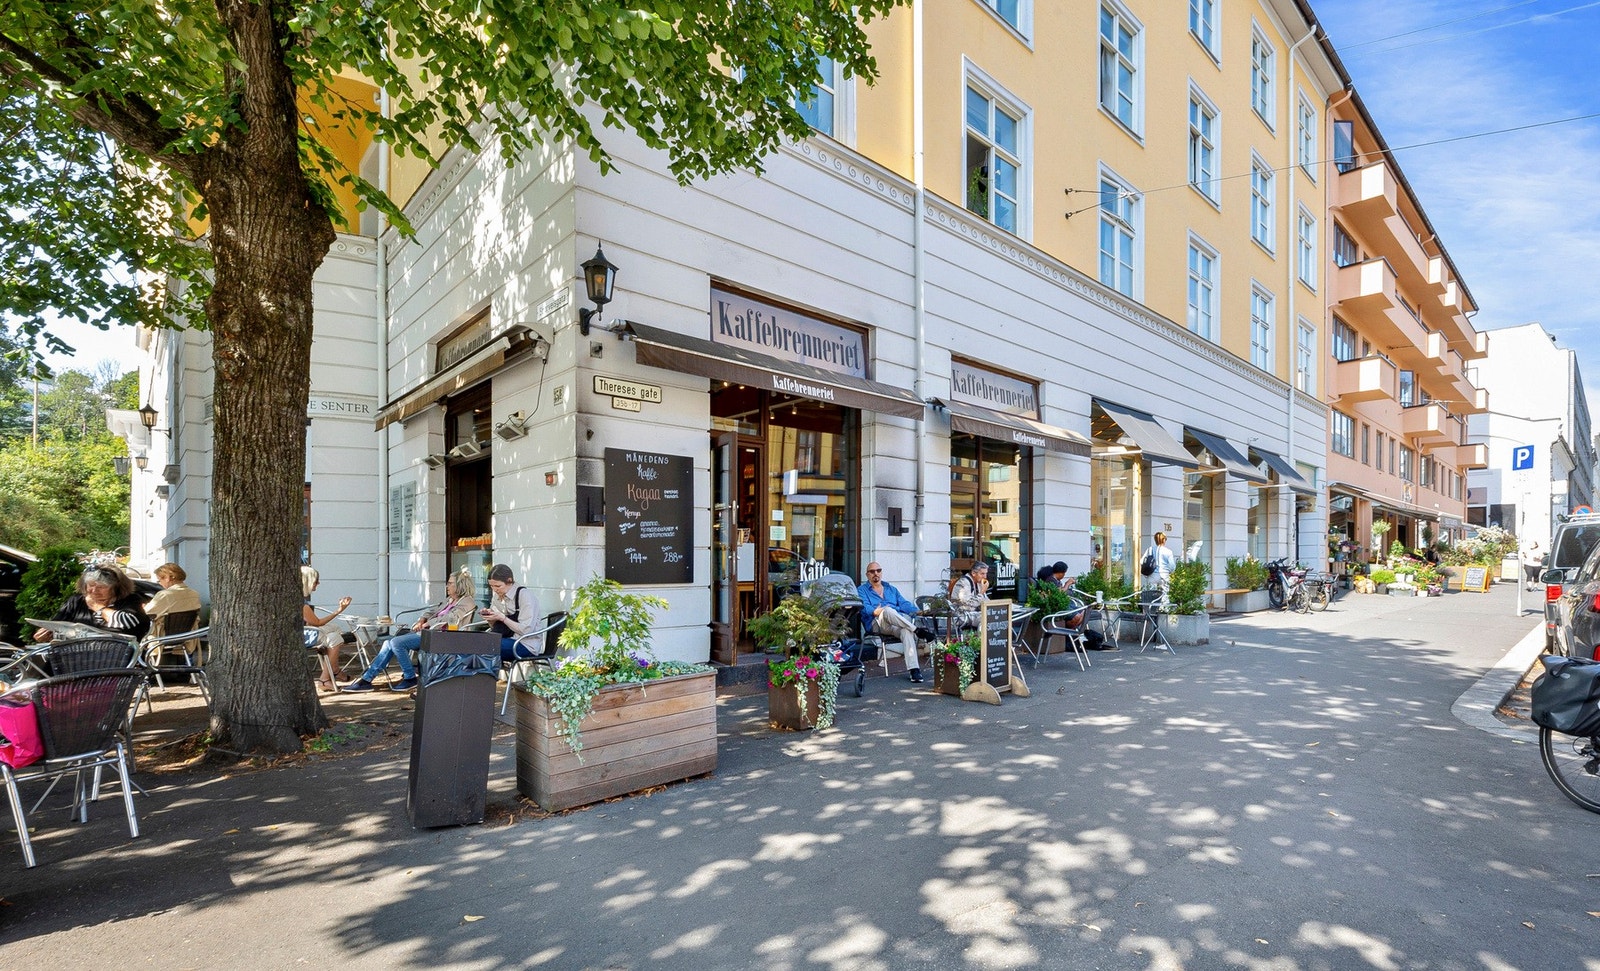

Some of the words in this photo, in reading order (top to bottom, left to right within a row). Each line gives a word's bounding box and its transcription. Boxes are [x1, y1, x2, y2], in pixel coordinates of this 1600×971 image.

[717, 300, 862, 370] Kaffebrenneriet
[599, 379, 637, 396] Thereses
[640, 387, 658, 399] gate
[772, 374, 835, 401] Kaffebrenneriet
[952, 369, 1035, 412] Kaffebrenneriet
[321, 400, 370, 413] SENTER
[1012, 430, 1046, 447] Kaffebrenneriet
[626, 452, 669, 465] MÅNEDENS
[1516, 448, 1530, 468] P
[627, 483, 661, 510] Kagaa
[800, 561, 830, 581] Kaffe
[996, 562, 1016, 578] Kaffe
